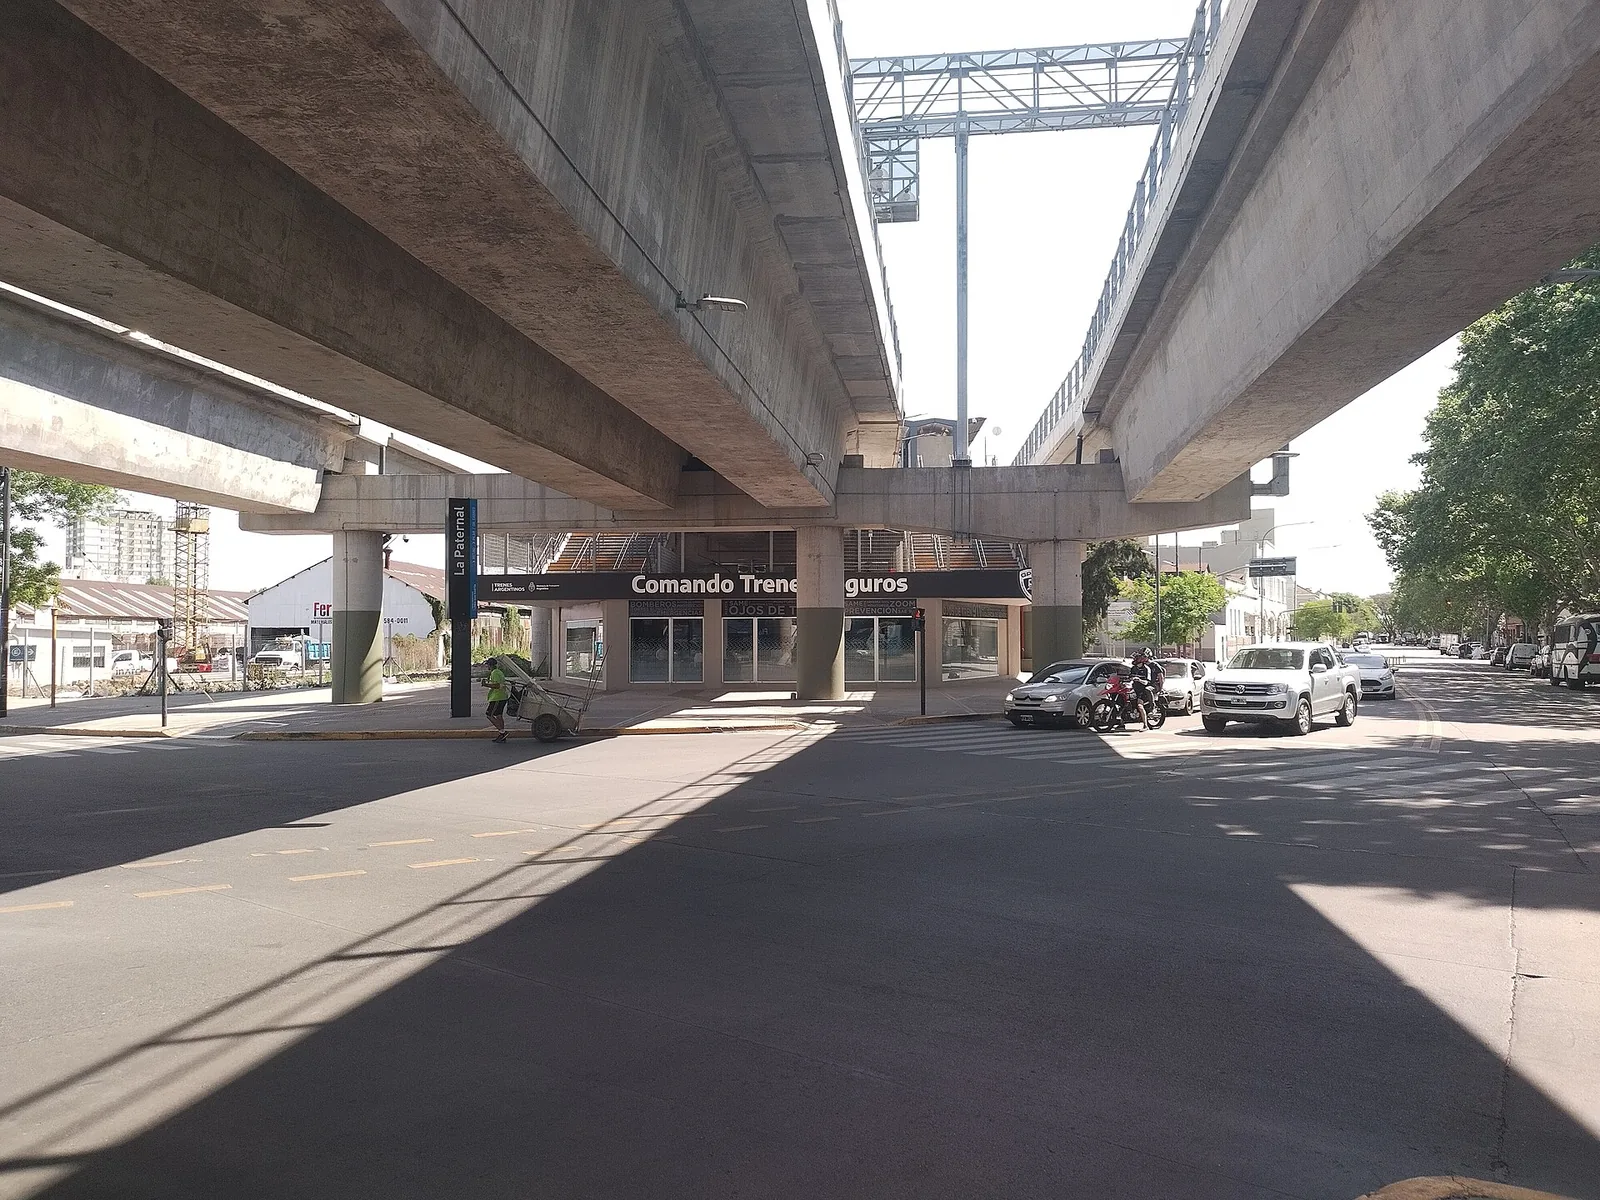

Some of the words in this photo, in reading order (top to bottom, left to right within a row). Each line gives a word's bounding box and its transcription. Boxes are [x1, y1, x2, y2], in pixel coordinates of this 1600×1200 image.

[453, 506, 466, 558] Paternal
[454, 561, 465, 576] La
[631, 574, 734, 594] Comando
[739, 574, 798, 594] Trene
[845, 577, 909, 598] guros
[313, 602, 333, 617] Fer
[728, 605, 764, 615] OJOS
[768, 605, 786, 615] DE
[789, 605, 797, 615] T
[844, 605, 898, 614] PREVENCIÓN
[889, 600, 916, 608] ZOOM
